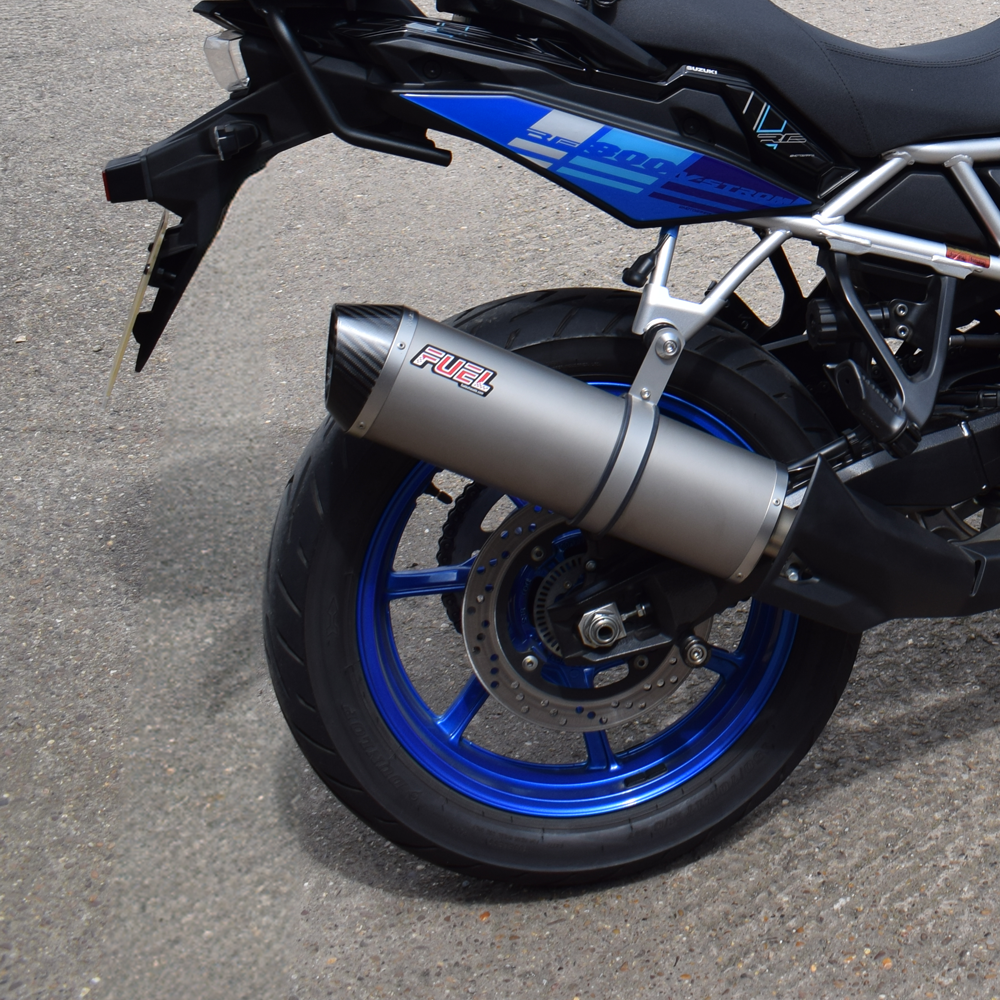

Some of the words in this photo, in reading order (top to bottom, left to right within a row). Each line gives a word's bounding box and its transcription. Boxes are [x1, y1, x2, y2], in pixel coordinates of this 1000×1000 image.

[685, 65, 718, 75] SUZUKI
[588, 141, 678, 176] 800
[679, 171, 800, 205] V-STROM
[411, 344, 496, 394] FUEL
[342, 704, 407, 790] DUNLOP
